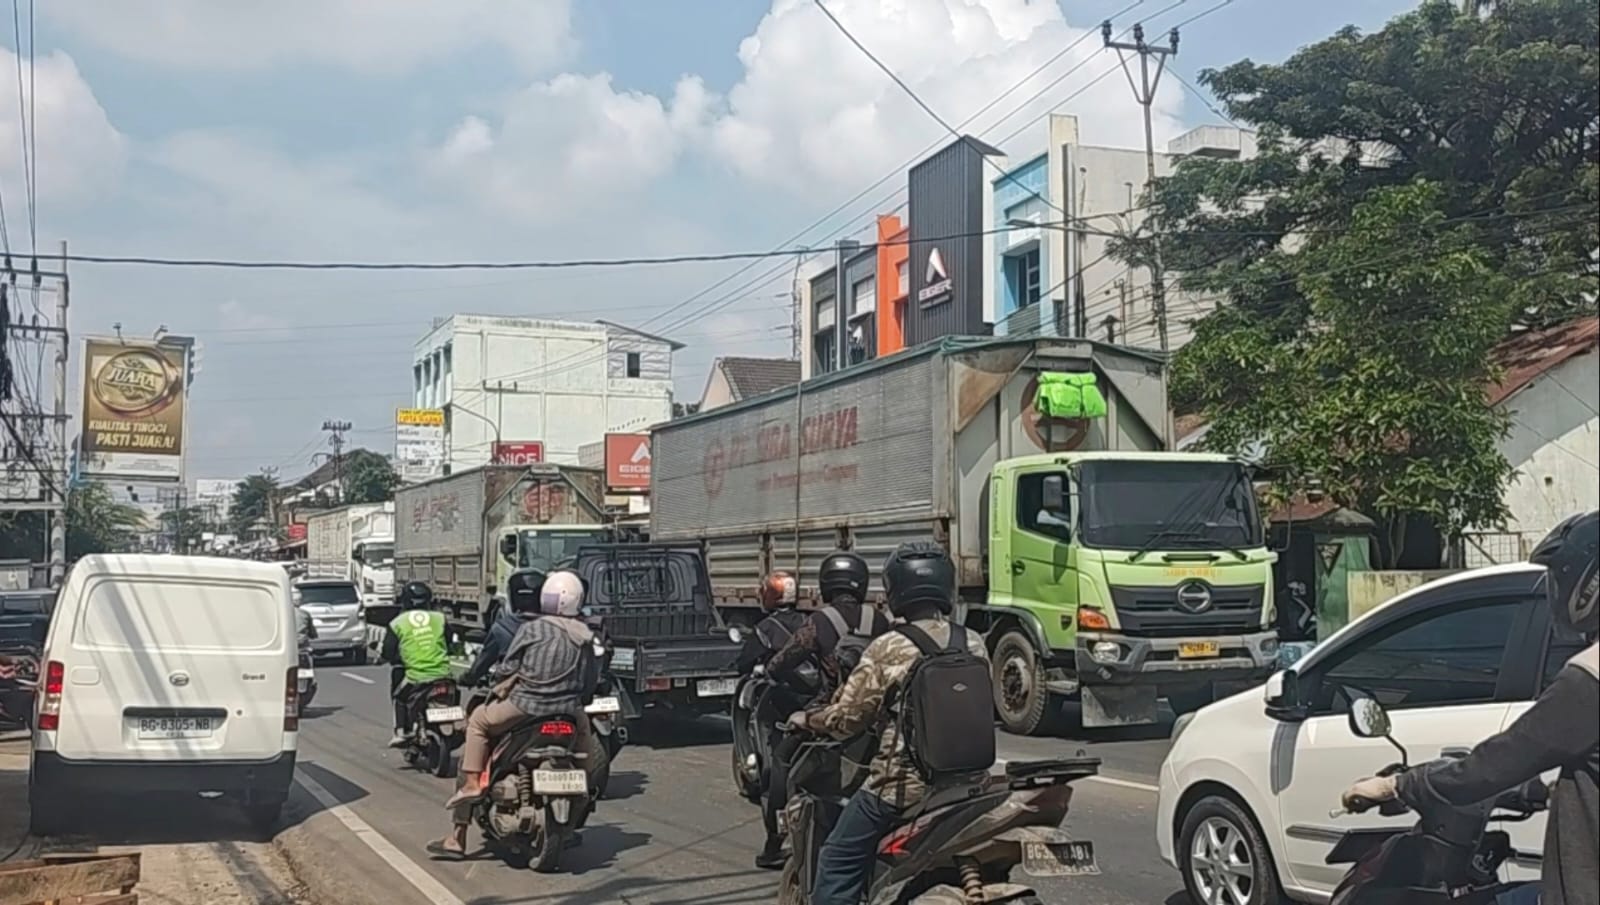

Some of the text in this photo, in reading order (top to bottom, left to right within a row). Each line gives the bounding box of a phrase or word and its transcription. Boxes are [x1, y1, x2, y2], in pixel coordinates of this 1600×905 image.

[106, 366, 156, 386] JUARA
[88, 420, 168, 433] KUALITAS TINGGI
[802, 407, 857, 449] SURYA
[96, 432, 176, 449] PASTI JUARA!
[619, 464, 651, 473] EIGE
